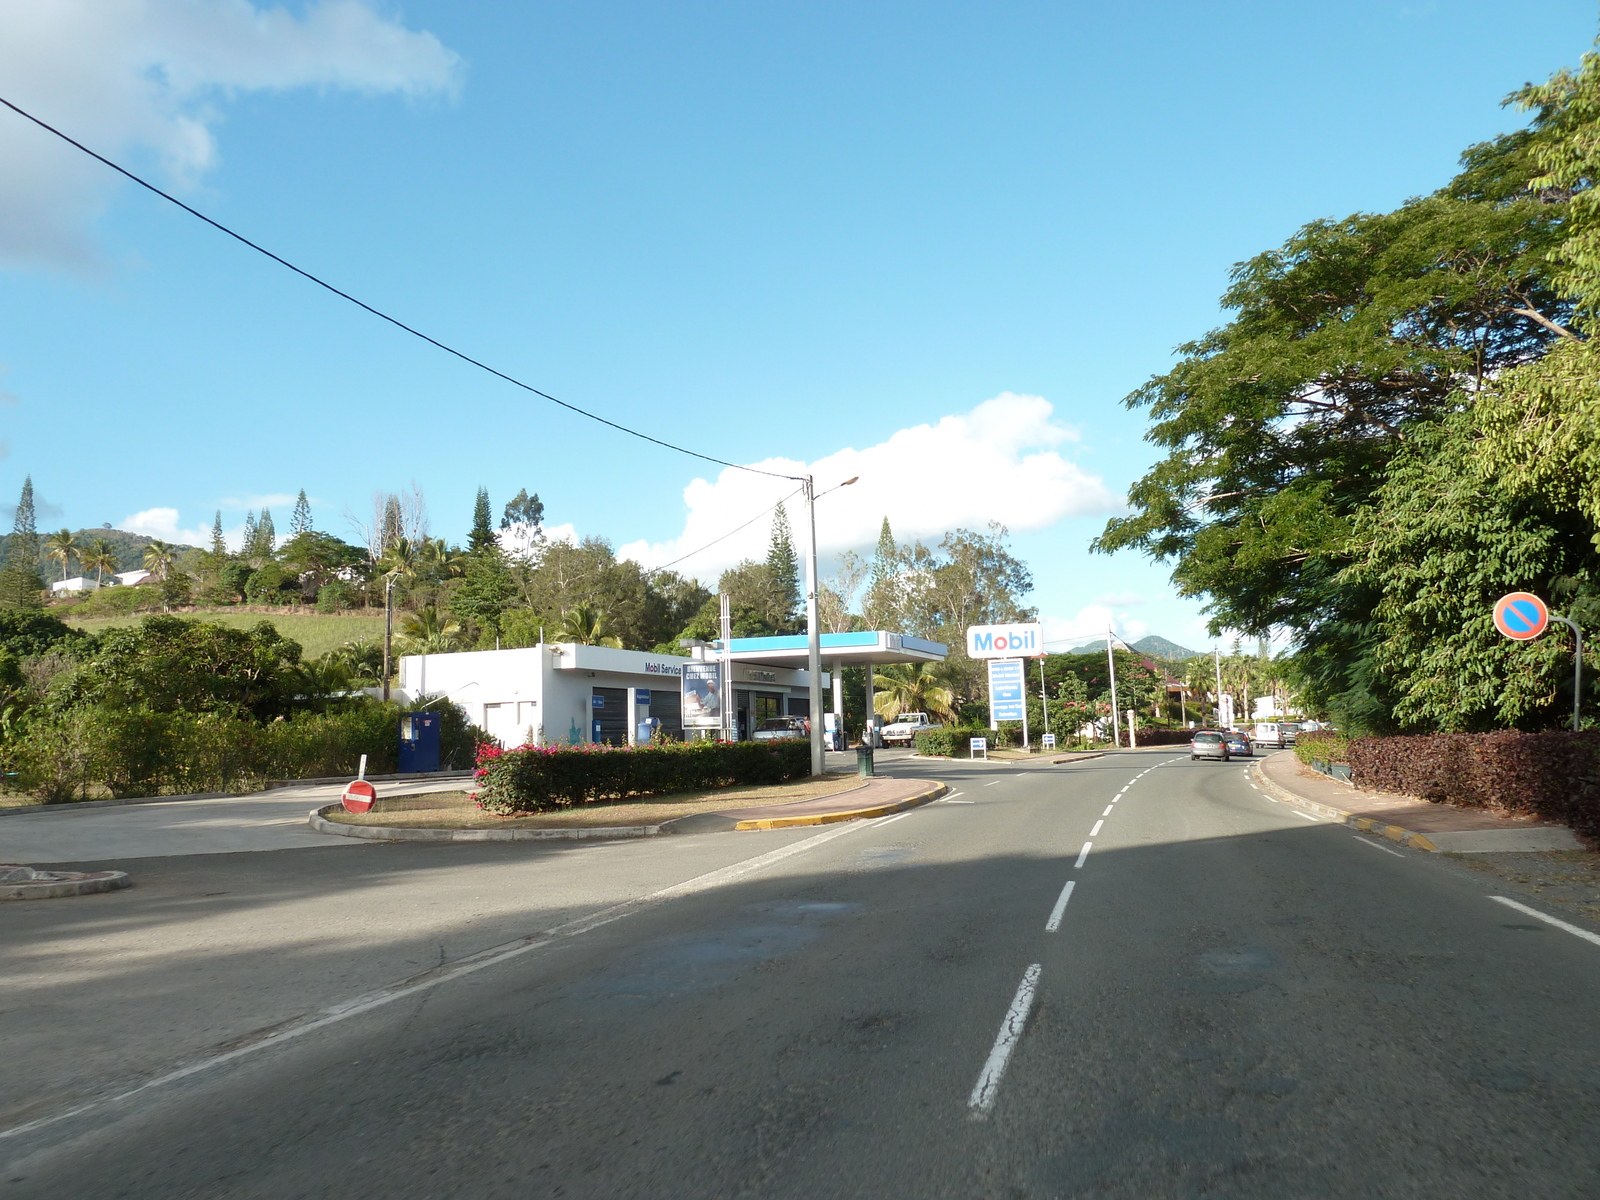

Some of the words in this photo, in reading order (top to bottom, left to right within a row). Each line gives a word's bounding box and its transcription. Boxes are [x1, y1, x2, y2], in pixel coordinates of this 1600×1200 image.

[974, 630, 1034, 650] Mobil
[645, 662, 660, 673] Mobil
[687, 665, 716, 673] BIENVENUE
